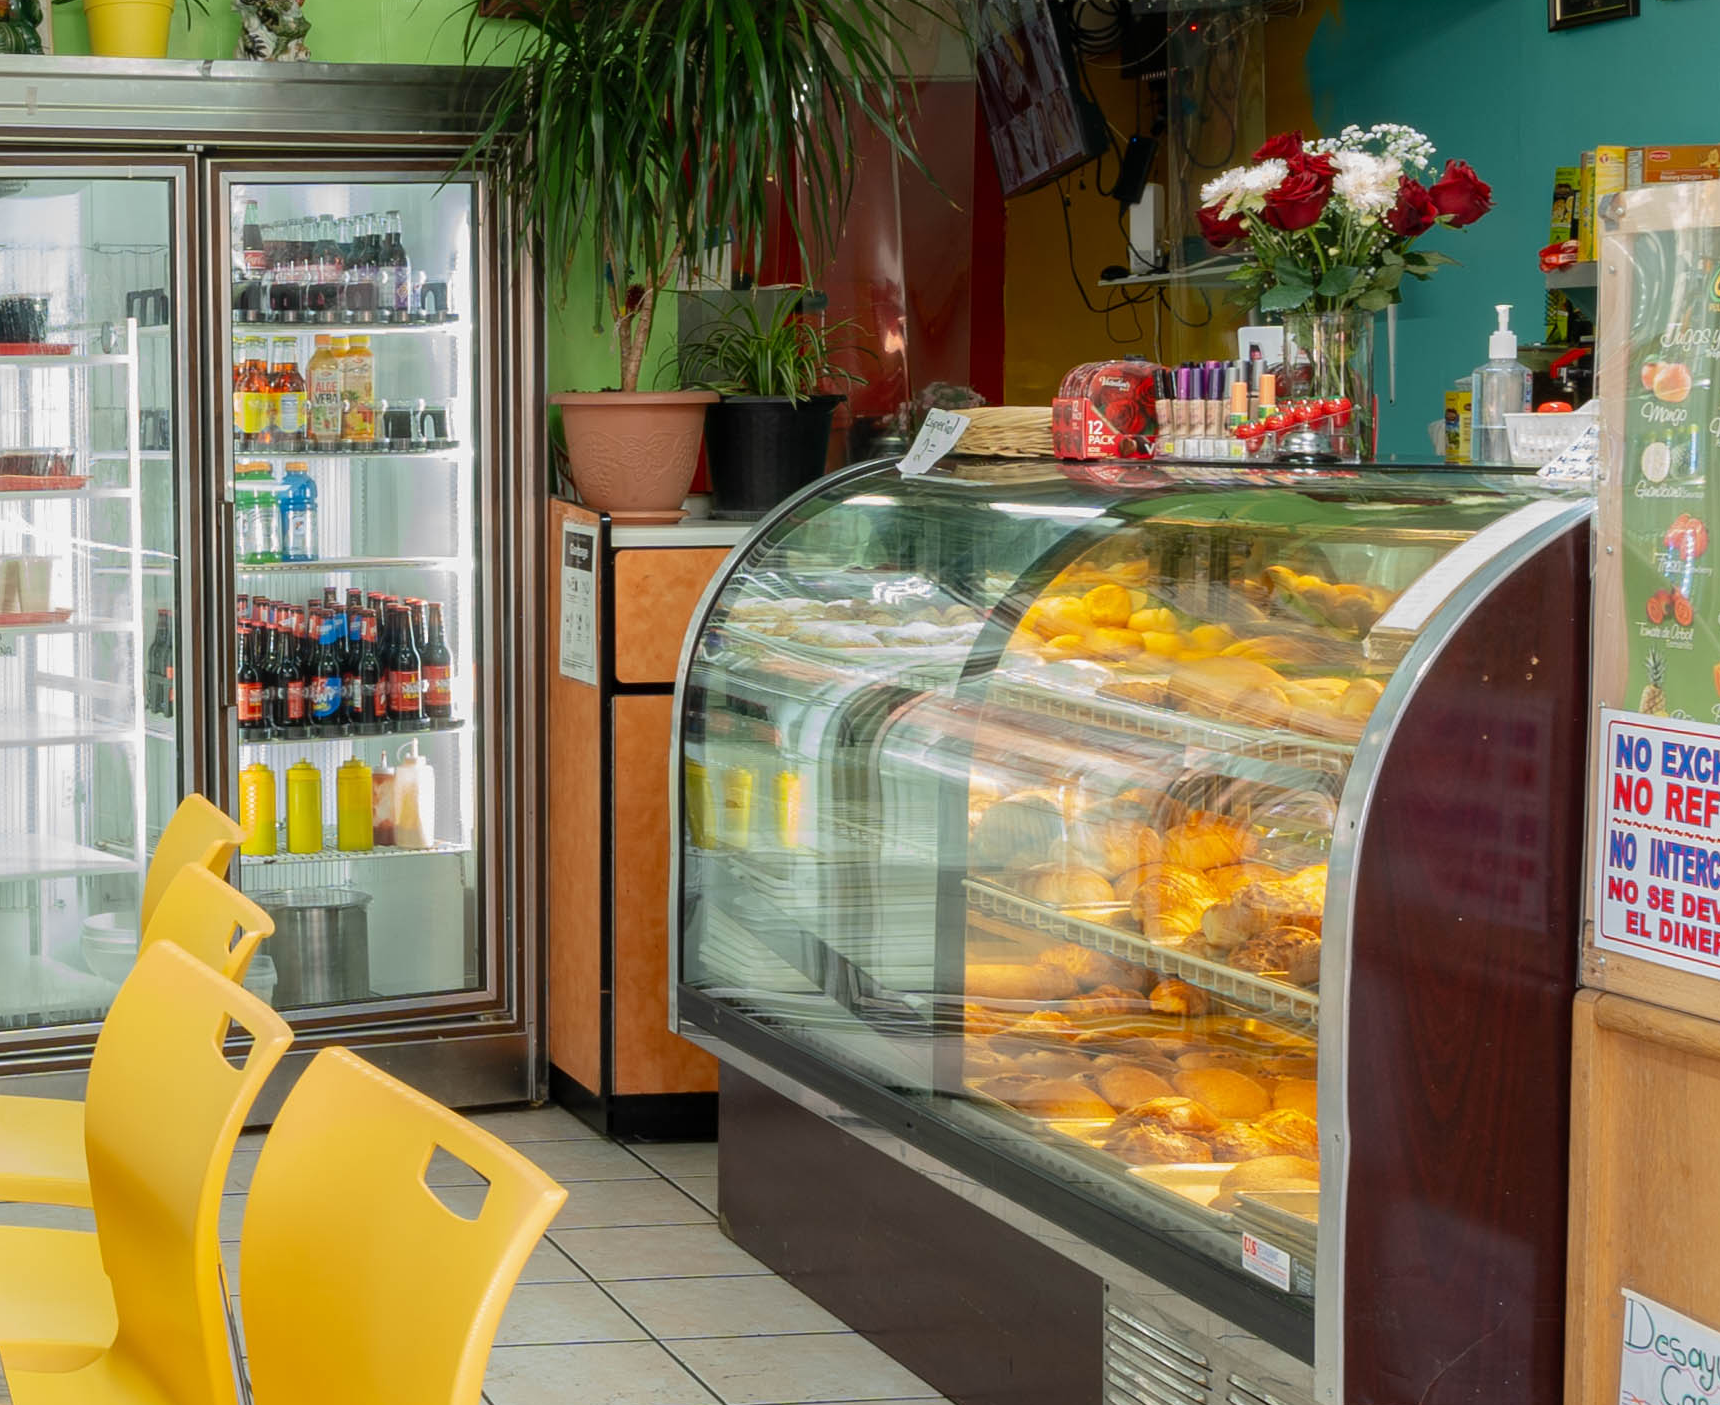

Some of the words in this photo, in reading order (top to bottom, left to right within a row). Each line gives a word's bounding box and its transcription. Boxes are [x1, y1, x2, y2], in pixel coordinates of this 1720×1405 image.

[1087, 421, 1103, 434] 12
[1641, 402, 1687, 426] Mango
[1088, 435, 1116, 445] PACK
[1615, 734, 1652, 772] NO
[1613, 774, 1653, 815] NO
[1609, 830, 1637, 871] NO
[1608, 876, 1638, 905] NO
[1647, 885, 1675, 914] SE
[1625, 910, 1652, 938] EL
